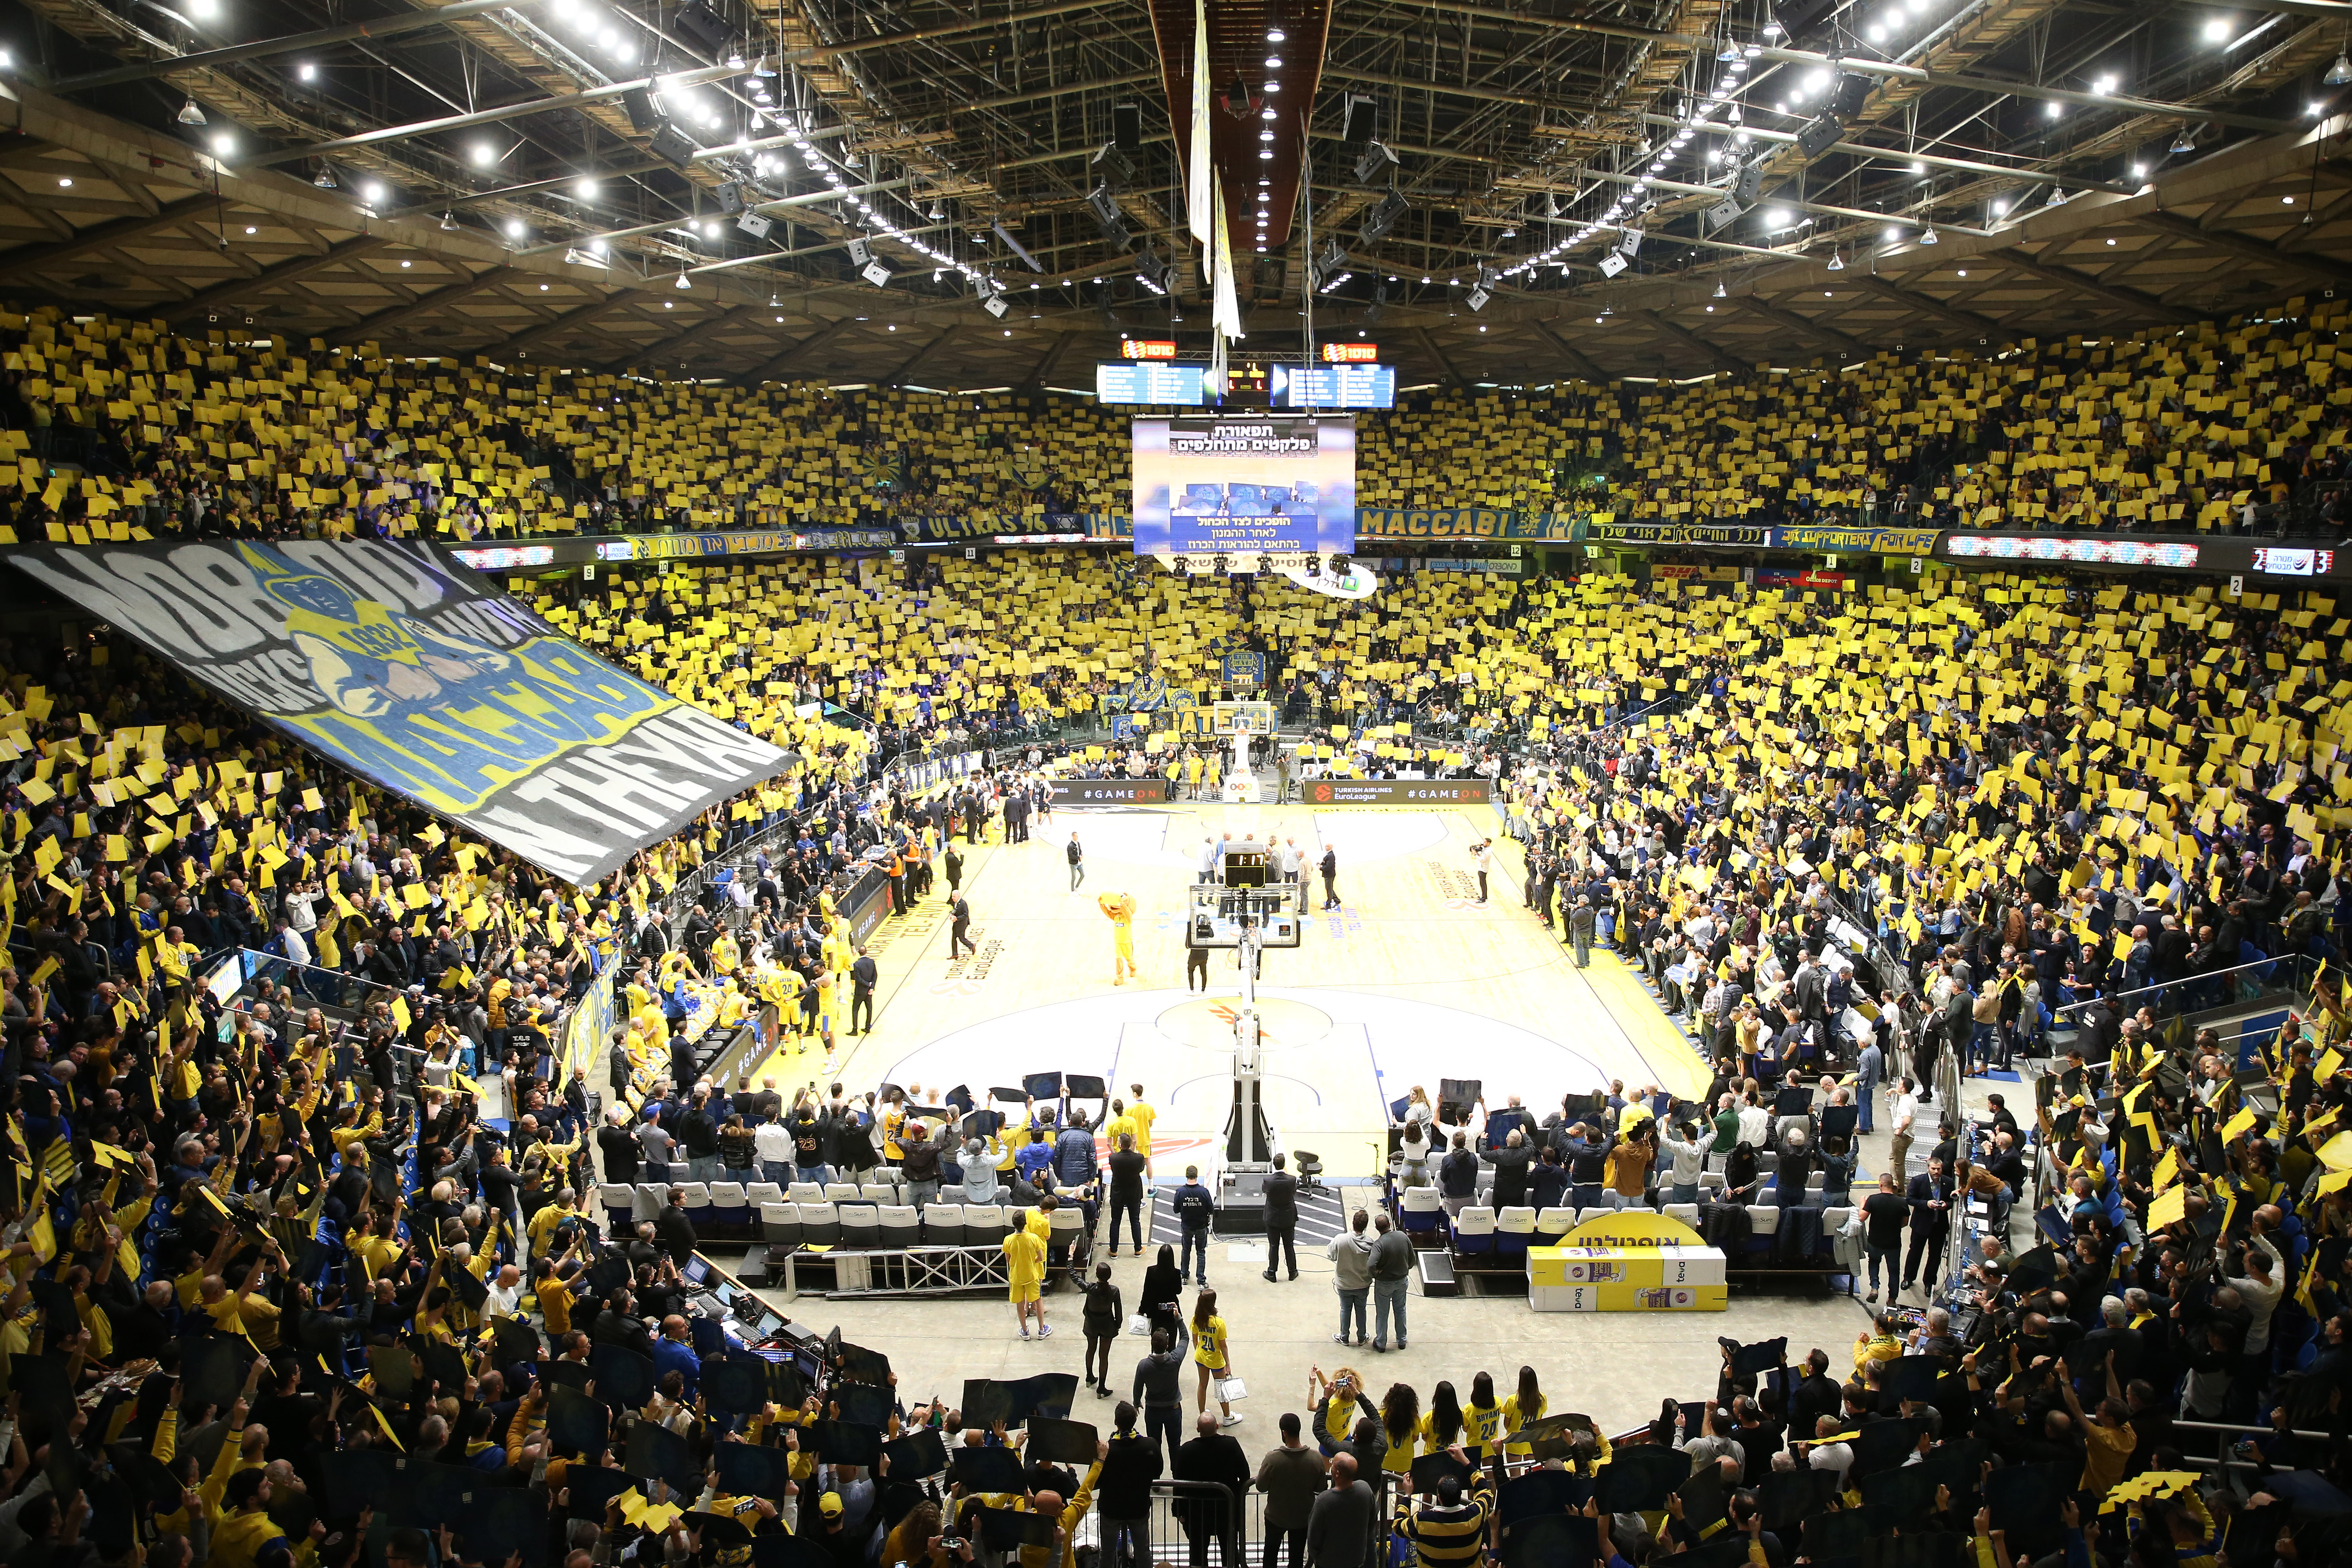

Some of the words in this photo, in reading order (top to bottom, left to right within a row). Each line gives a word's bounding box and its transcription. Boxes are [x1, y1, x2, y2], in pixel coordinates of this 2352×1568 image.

[1147, 345, 1175, 356] טוטו
[1348, 348, 1376, 359] טוטו
[1214, 426, 1273, 437] תפאורת
[1177, 437, 1248, 451] מתחלפים
[1252, 437, 1310, 453] פלקטים
[1020, 515, 1048, 533] 96
[1196, 516, 1229, 526] הכחול
[1231, 516, 1252, 526] לצד
[1254, 517, 1291, 526] הופכים
[1362, 510, 1509, 537] MACCABI
[1211, 529, 1246, 539] ההמנון
[1249, 527, 1276, 538] לאחר
[1188, 540, 1215, 549] הכרוז
[1218, 539, 1260, 549] להוראות
[1264, 540, 1300, 549] בהתאם
[596, 544, 605, 559] 9
[896, 552, 903, 560] 10
[1829, 557, 1833, 565] 1
[2252, 549, 2264, 570] 2
[2315, 552, 2328, 573] 3
[660, 562, 667, 571] 10
[1914, 561, 1919, 570] 2
[587, 569, 592, 578] 9
[1662, 567, 1698, 578] DH
[2233, 579, 2239, 592] 2
[338, 622, 419, 658] 1932
[1334, 793, 1376, 802] EuroLeague
[1328, 916, 1345, 938] MACCABI
[782, 984, 792, 995] 24
[887, 1130, 896, 1142] 2
[798, 1137, 816, 1151] 23
[1676, 1261, 1686, 1283] teva
[1575, 1288, 1583, 1309] teva
[1201, 1335, 1215, 1352] 24
[1476, 1410, 1500, 1423] BRYANT
[1481, 1421, 1497, 1441] 24
